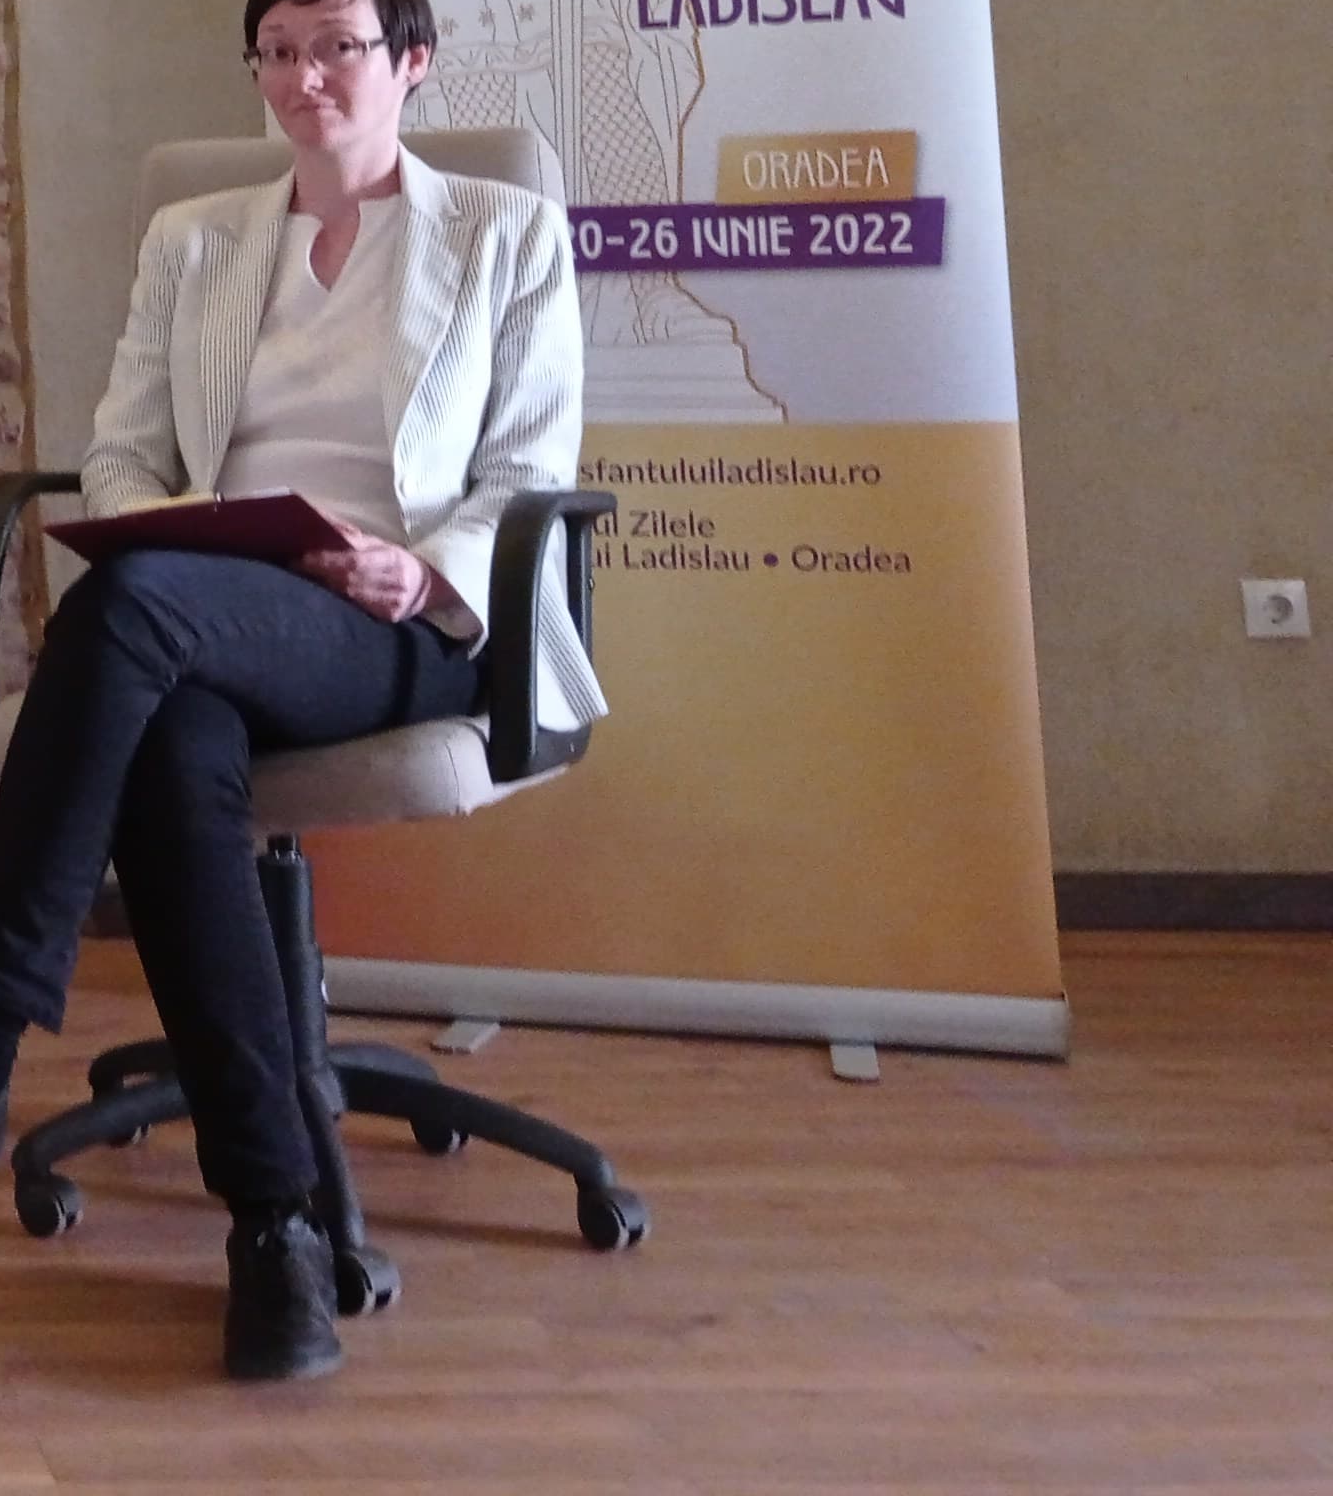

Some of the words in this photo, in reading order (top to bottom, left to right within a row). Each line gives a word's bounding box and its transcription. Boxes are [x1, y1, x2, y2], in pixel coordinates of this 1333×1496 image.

[743, 146, 890, 189] ORADEA
[569, 218, 678, 260] 0-26
[692, 215, 794, 259] IUNIE
[809, 211, 913, 256] 2022
[580, 457, 881, 485] sfantuluiladislau.ro
[630, 507, 716, 537] Zilele
[623, 541, 750, 571] Ladislau
[791, 543, 912, 573] Oradea
